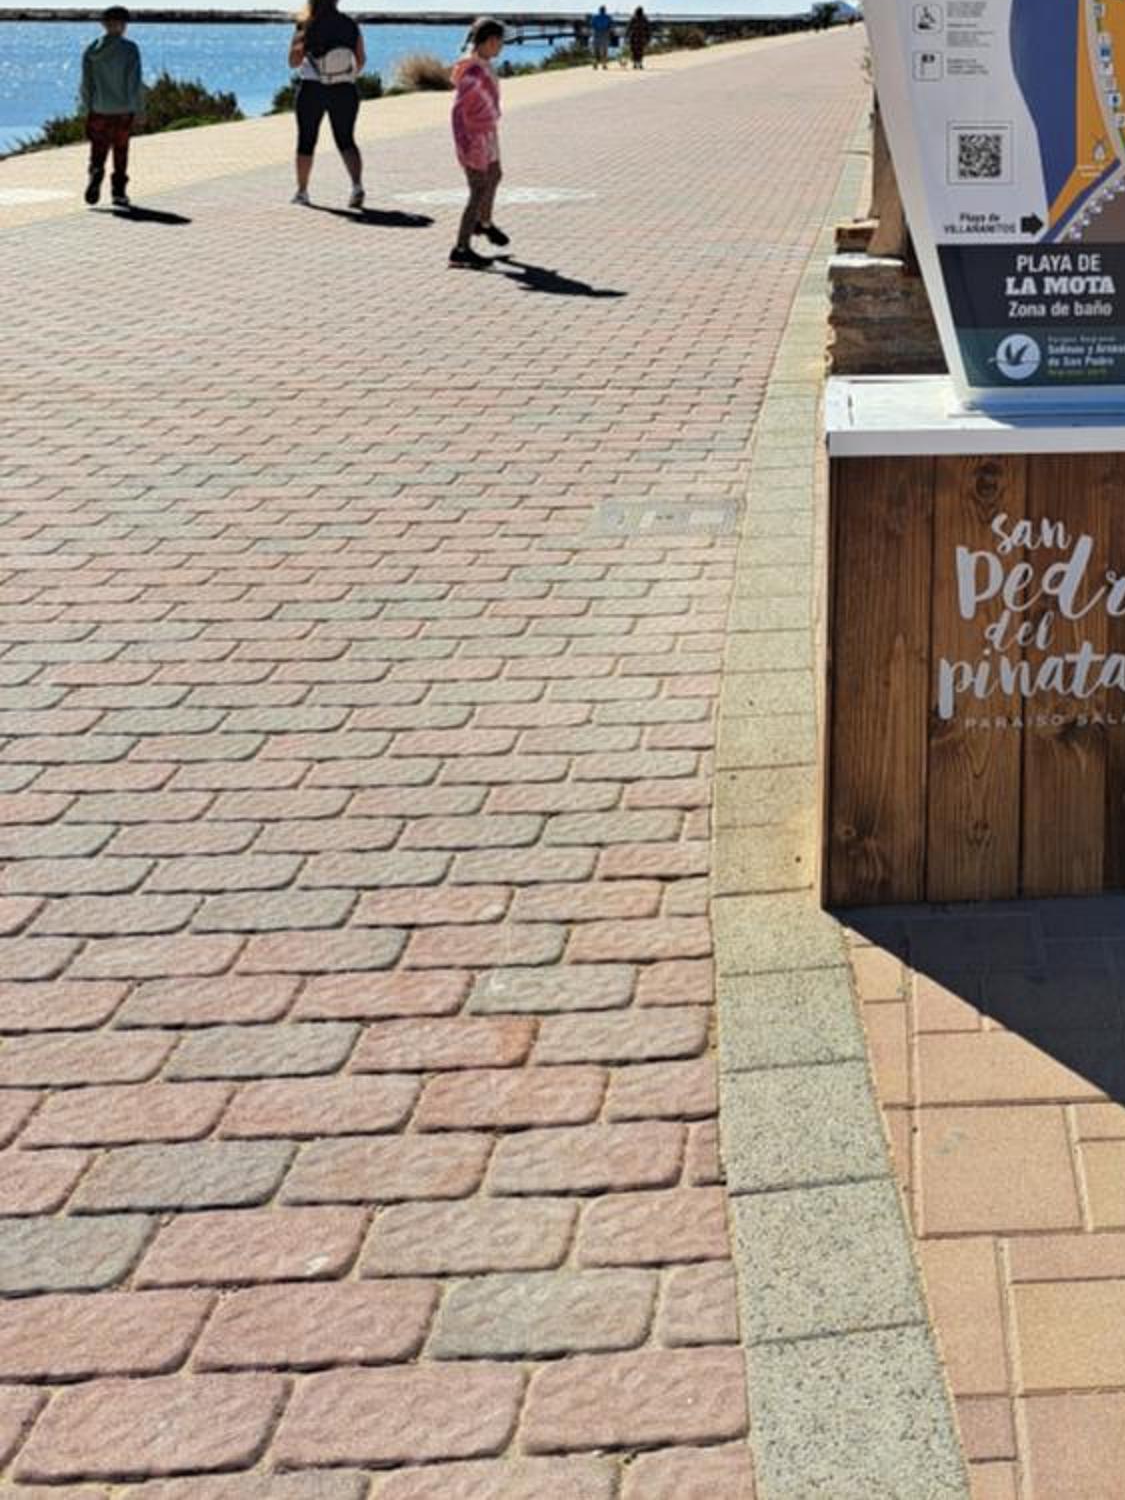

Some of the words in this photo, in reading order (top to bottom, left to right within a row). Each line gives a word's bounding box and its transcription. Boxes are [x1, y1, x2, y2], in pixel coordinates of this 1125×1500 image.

[1016, 254, 1073, 273] PLAYA
[1077, 254, 1102, 272] DE
[1004, 276, 1038, 296] LA
[1042, 275, 1116, 296] MOTA
[1008, 301, 1046, 318] Zona
[1050, 300, 1070, 317] de
[1073, 299, 1114, 317] baño
[990, 512, 1073, 555] san
[984, 609, 1055, 652] del
